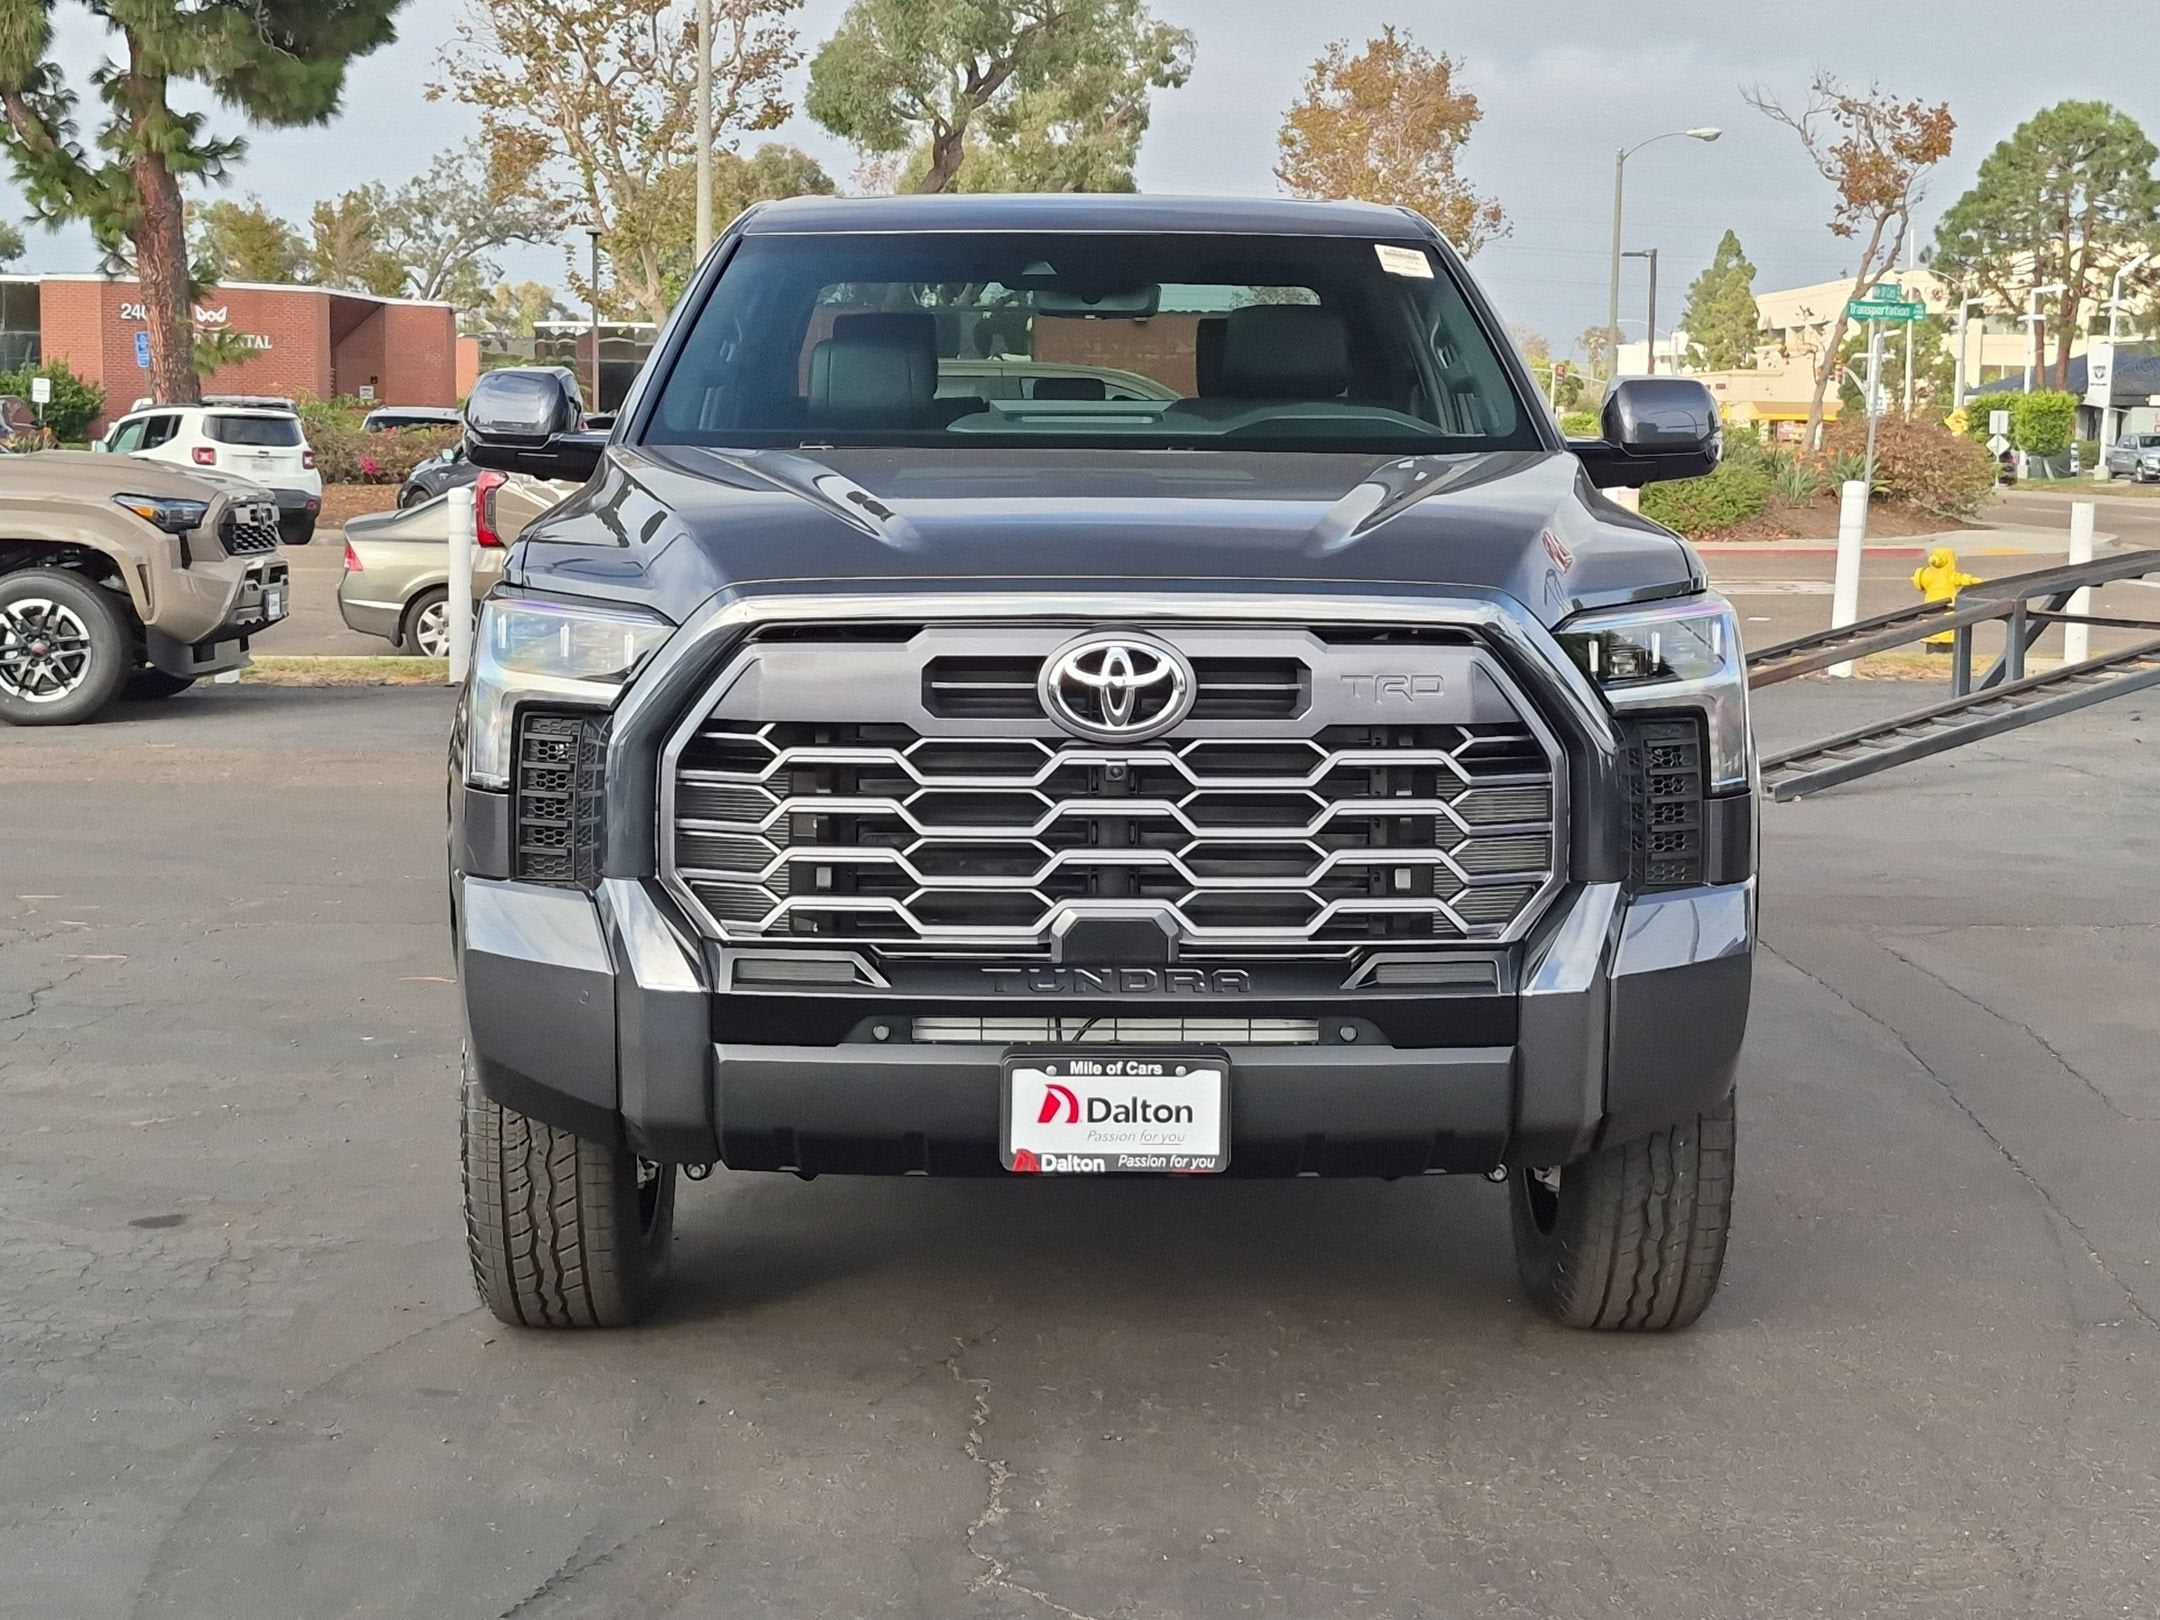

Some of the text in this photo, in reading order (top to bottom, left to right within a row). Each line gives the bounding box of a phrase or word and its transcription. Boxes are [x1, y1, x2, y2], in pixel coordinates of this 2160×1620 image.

[1850, 302, 1909, 317] Transportation
[1340, 674, 1444, 704] TRD
[981, 968, 1250, 993] TUNDRA
[1070, 1061, 1163, 1075] Mile of Cars
[1087, 1096, 1193, 1123] Dalton
[1087, 1129, 1185, 1145] Passion for you
[1041, 1153, 1215, 1172] Dalton Passion for you
